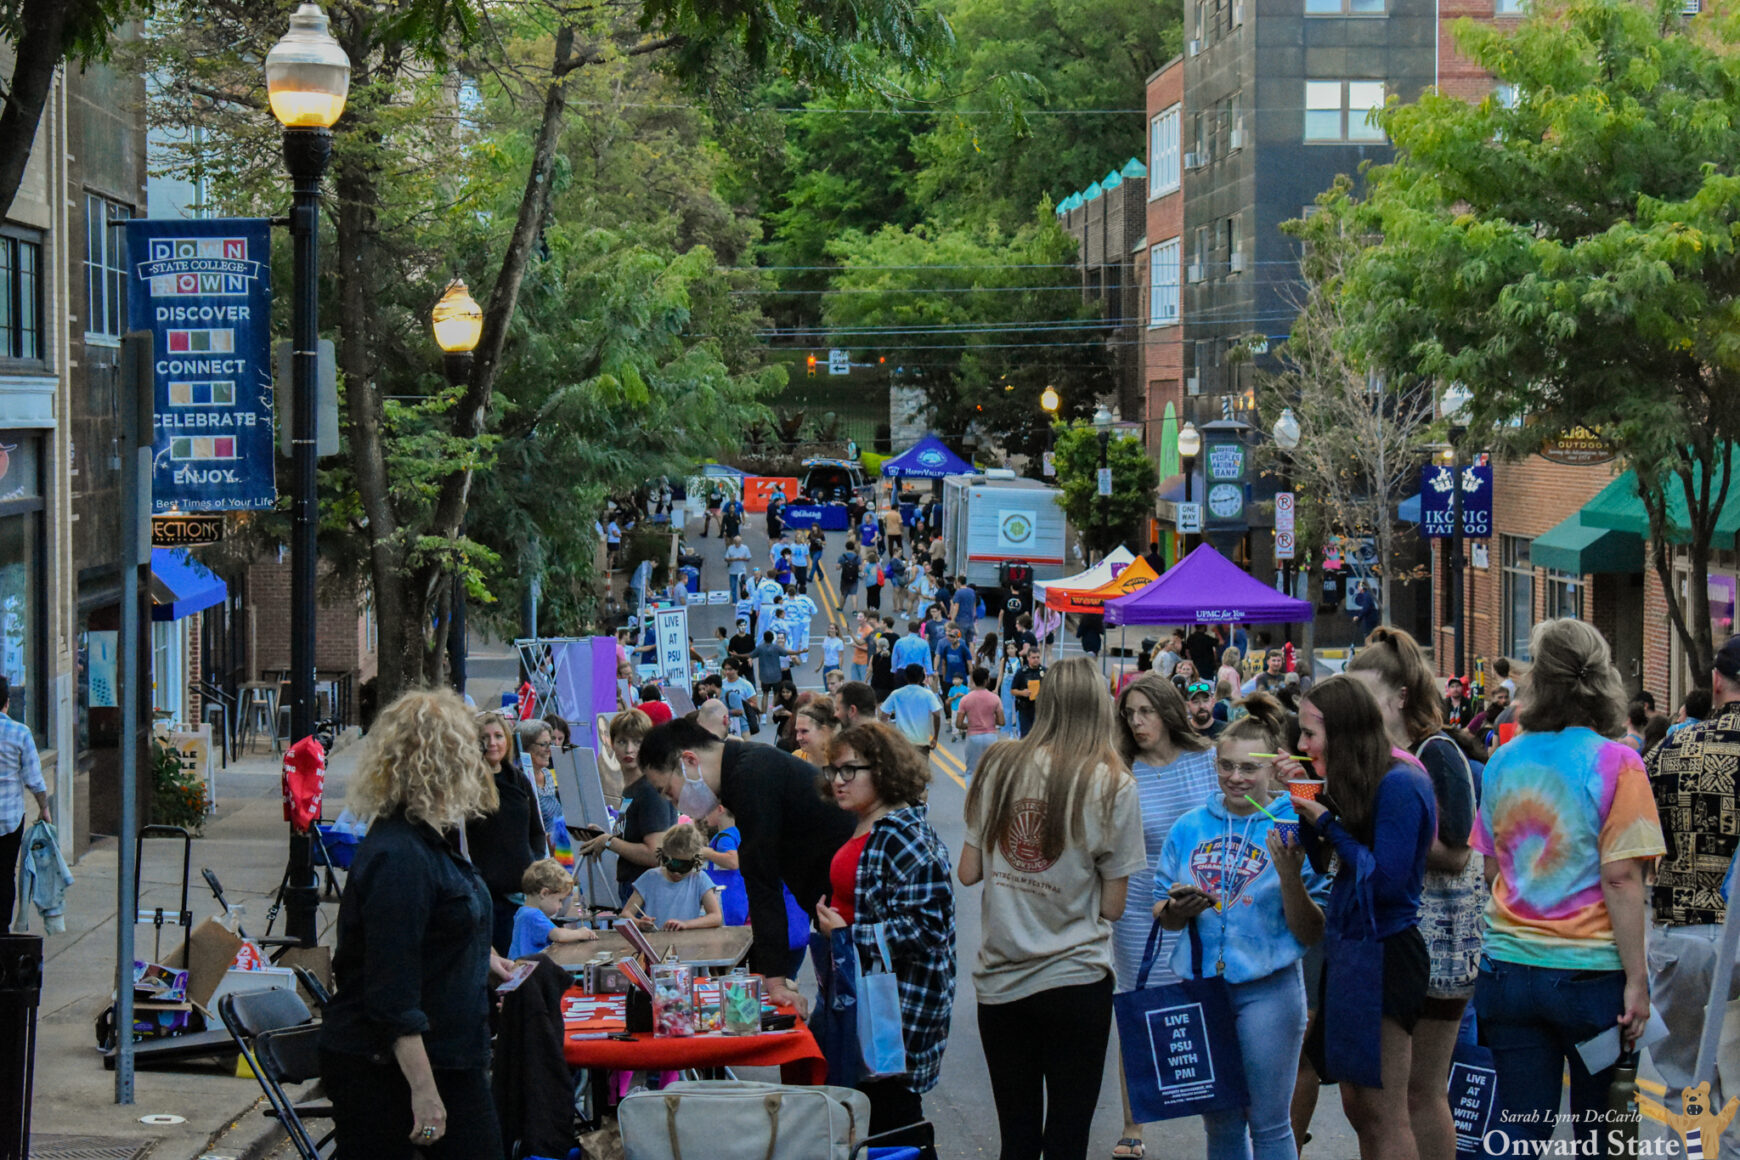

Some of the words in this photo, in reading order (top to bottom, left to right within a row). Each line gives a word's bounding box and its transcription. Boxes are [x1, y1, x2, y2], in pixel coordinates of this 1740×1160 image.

[156, 306, 251, 321] DISCOVER
[156, 360, 247, 374] CONNECT
[173, 469, 236, 484] ENJOY
[156, 500, 179, 508] Best
[183, 499, 212, 507] Times
[215, 498, 225, 507] of
[228, 498, 251, 506] Your
[254, 497, 274, 506] Life
[1425, 524, 1488, 534] TATOO
[664, 616, 679, 628] LIVE
[669, 633, 677, 645] AT
[667, 650, 681, 662] PSU
[667, 668, 684, 679] WITH
[1164, 1013, 1190, 1027] LIVE
[1172, 1028, 1187, 1039] AT
[1169, 1040, 1193, 1053] PSU
[1167, 1053, 1198, 1067] WITH
[1174, 1067, 1196, 1080] PMI
[1465, 1073, 1487, 1086] LIVE
[1466, 1086, 1481, 1097] AT
[1460, 1096, 1480, 1109] PSU
[1454, 1107, 1479, 1120] WITH
[1454, 1119, 1473, 1132] PMI
